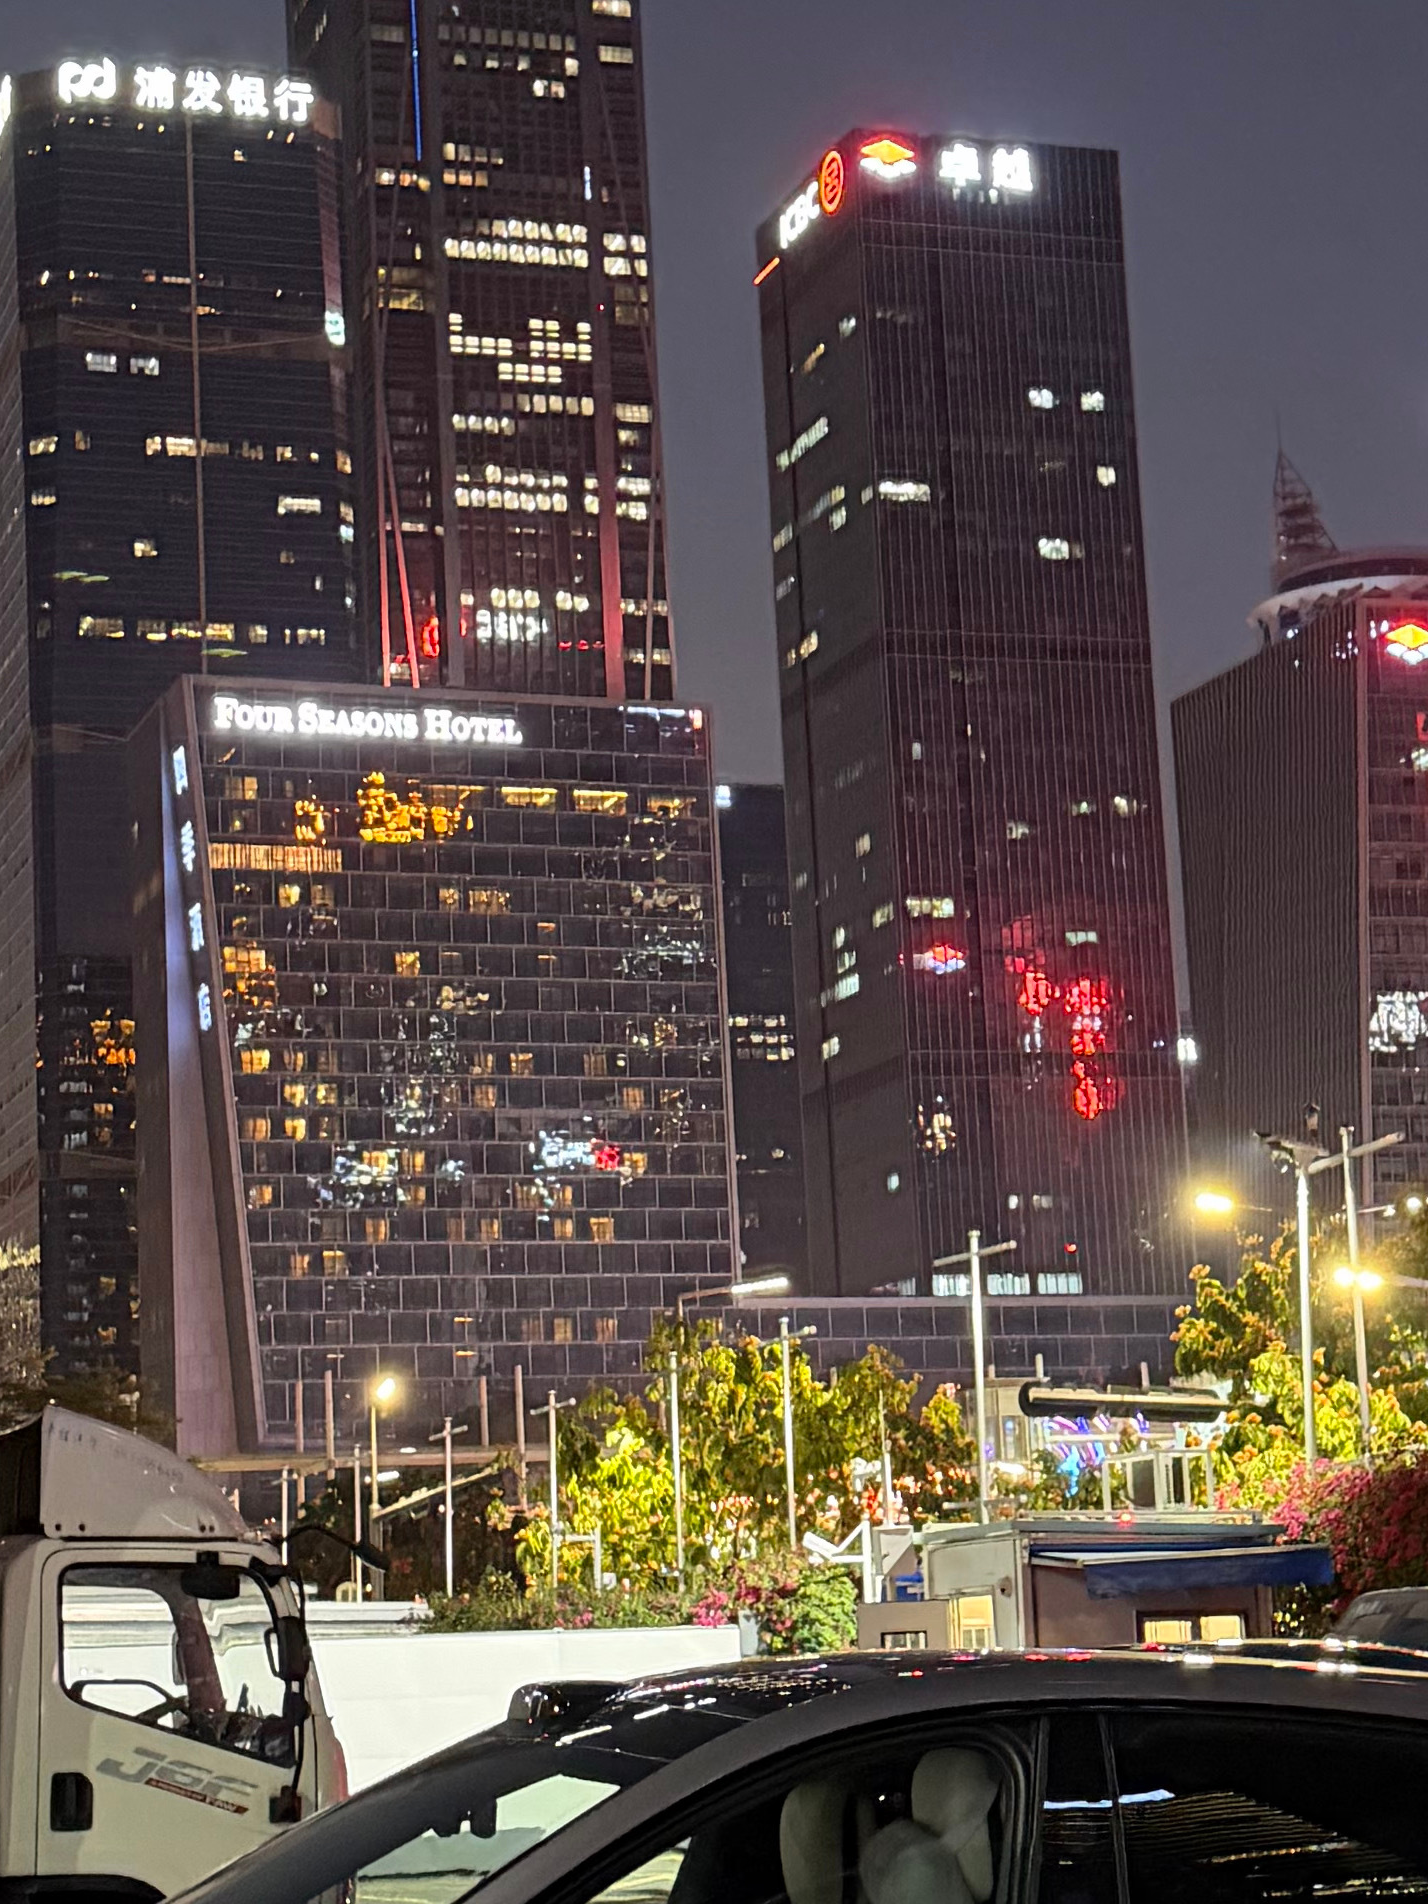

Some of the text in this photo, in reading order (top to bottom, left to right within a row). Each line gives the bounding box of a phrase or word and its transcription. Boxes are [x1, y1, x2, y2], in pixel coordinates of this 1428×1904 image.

[134, 66, 314, 122] 浦发银行
[779, 180, 820, 250] ICBC
[213, 696, 523, 744] FOUR SEASONS HOTEL
